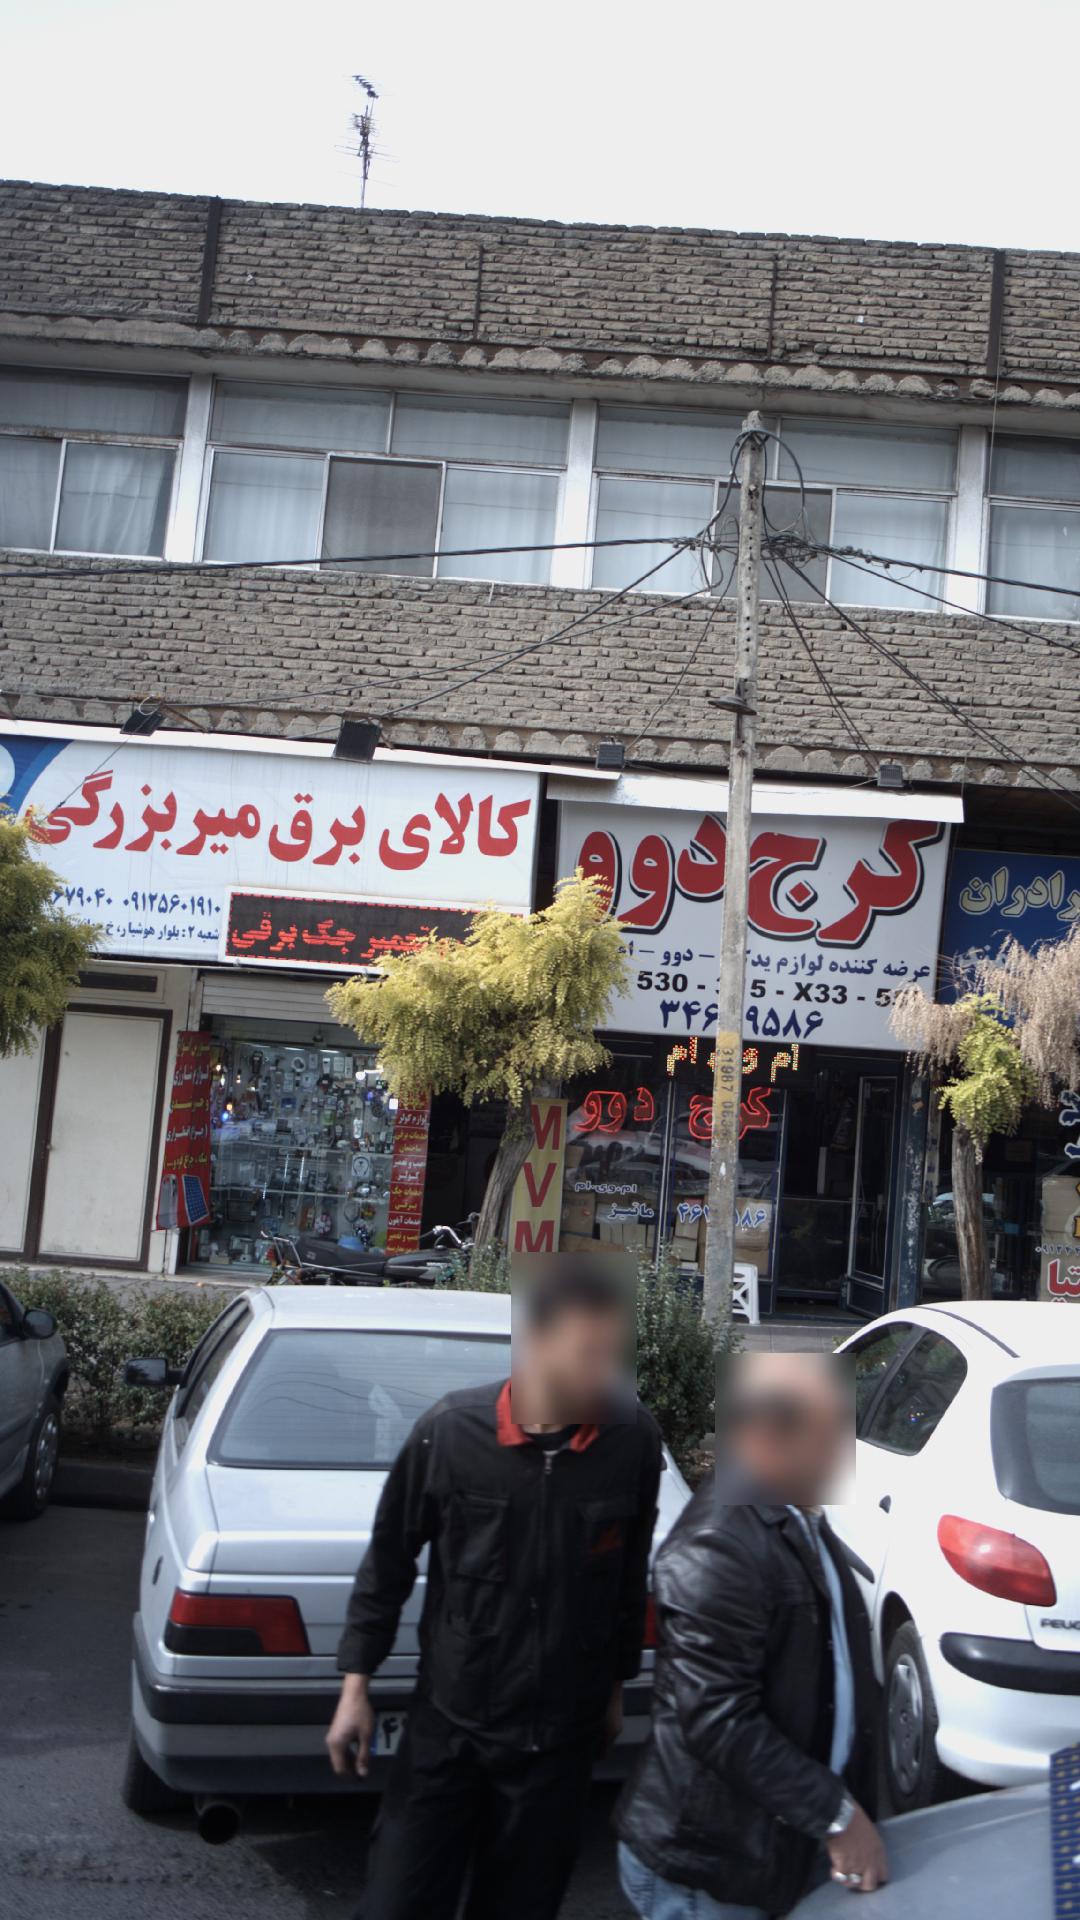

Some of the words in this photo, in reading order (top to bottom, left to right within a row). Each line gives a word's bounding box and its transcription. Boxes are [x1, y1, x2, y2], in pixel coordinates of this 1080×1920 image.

[268, 792, 366, 866] برق
[378, 792, 531, 871] کالای
[574, 812, 727, 934] دوو
[746, 819, 945, 949] کرج
[123, 890, 221, 916] ۰۹۱۲۵۶۰۱۹۱۰
[157, 924, 180, 940] بلوار
[197, 928, 220, 942] شعبه
[231, 911, 298, 952] برقی
[660, 948, 694, 967] دوو
[775, 953, 824, 977] لوازم
[828, 958, 878, 975] کننده
[882, 959, 931, 983] عرضه
[636, 971, 689, 993] 530
[793, 981, 848, 1005] X33
[660, 999, 824, 1039] ۳۴۶۹۵۸۶
[574, 1087, 655, 1133] دوو
[688, 1087, 772, 1140] کرج
[607, 1200, 655, 1220] ماتیز
